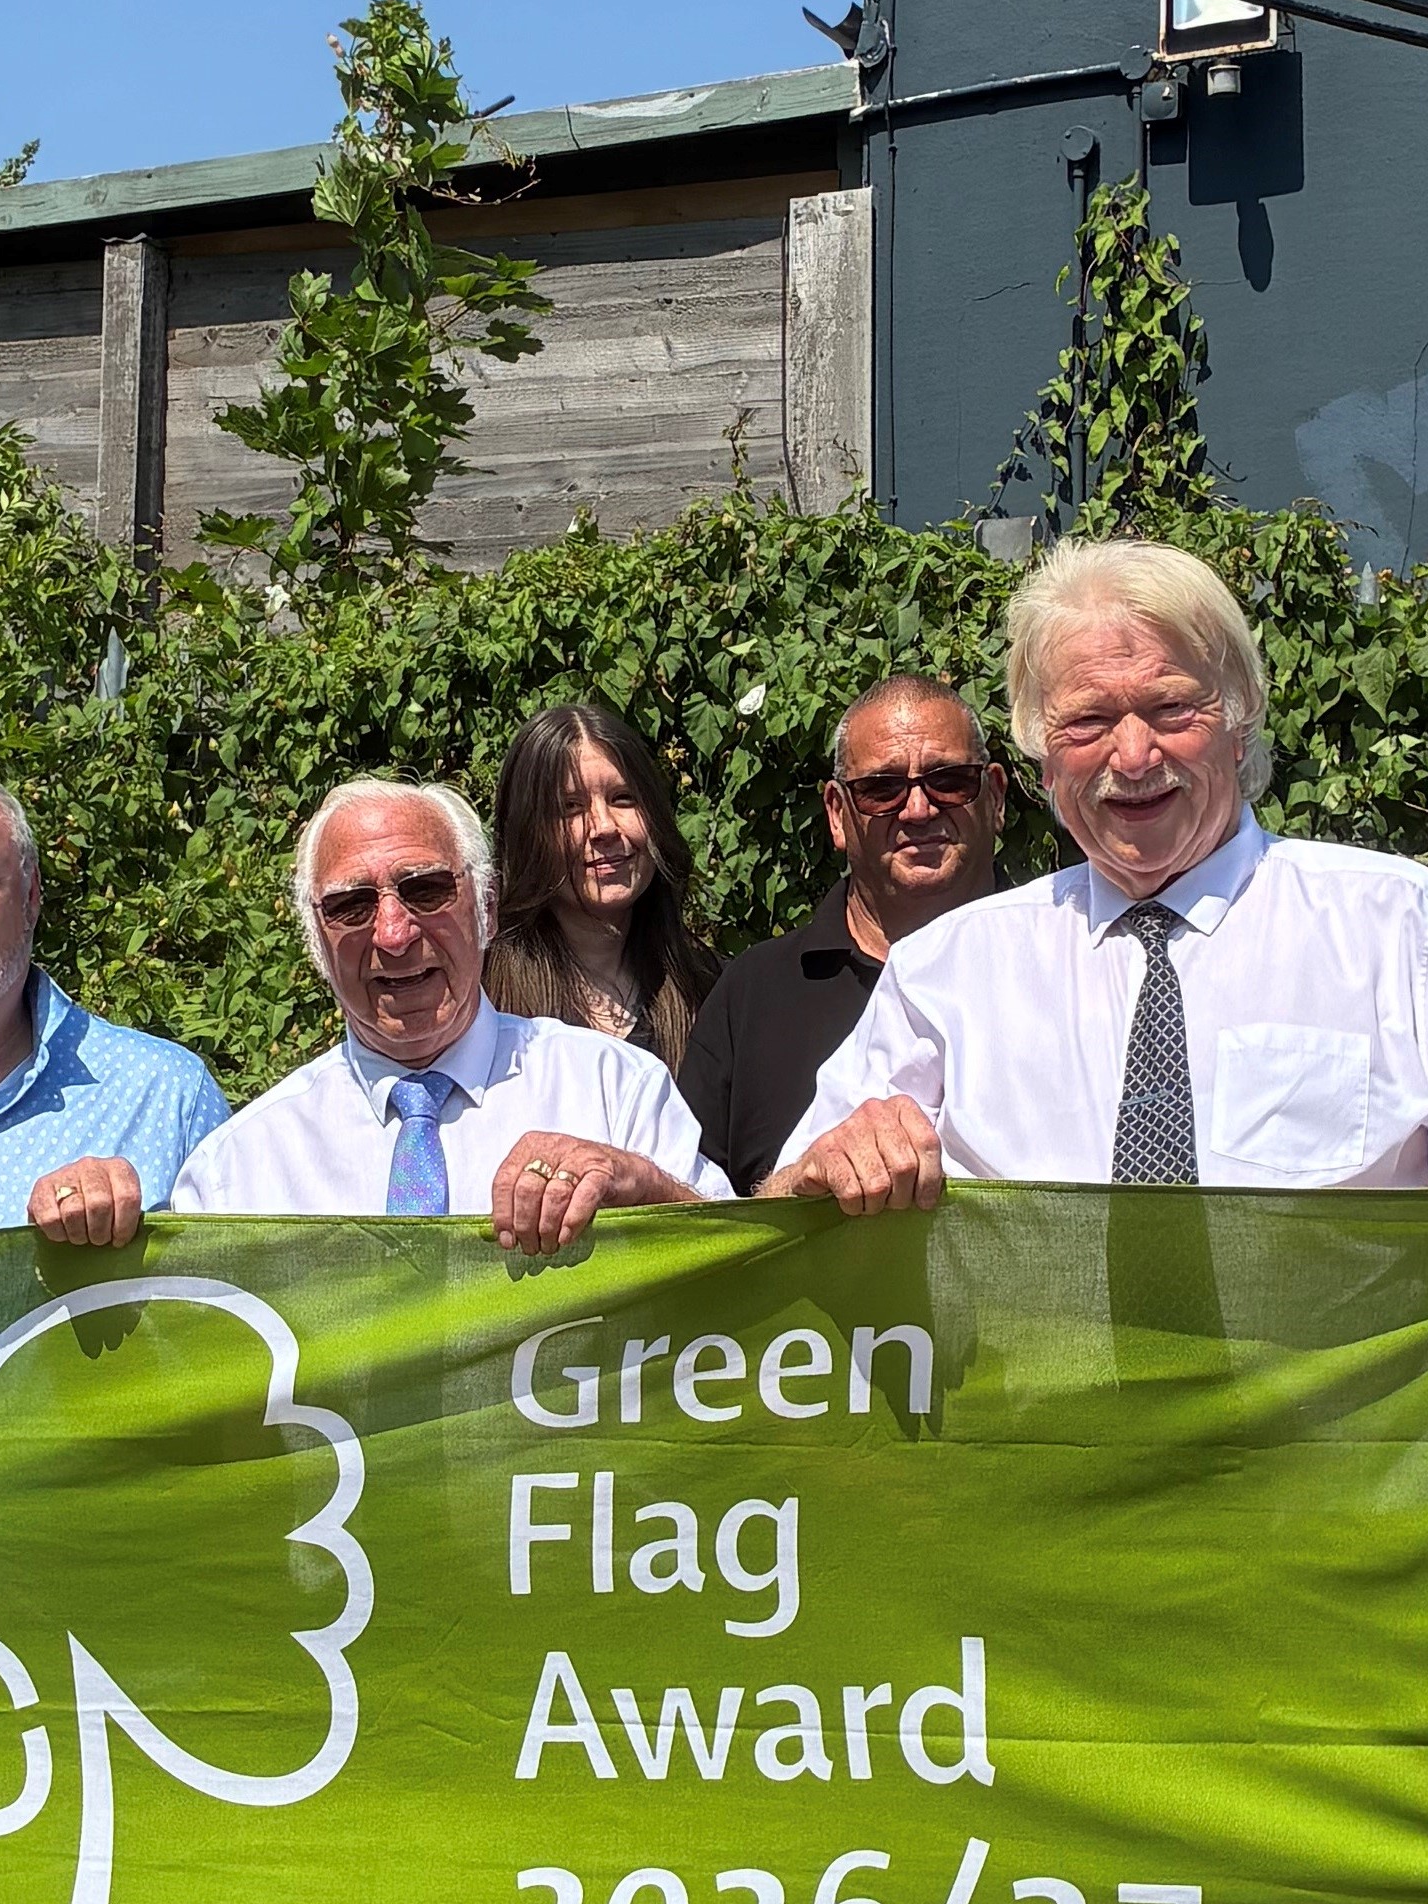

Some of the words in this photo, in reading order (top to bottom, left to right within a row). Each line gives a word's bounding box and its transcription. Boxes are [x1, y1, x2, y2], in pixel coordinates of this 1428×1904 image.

[510, 1314, 934, 1429] Green
[508, 1470, 801, 1638] Flag
[514, 1636, 997, 1787] Award
